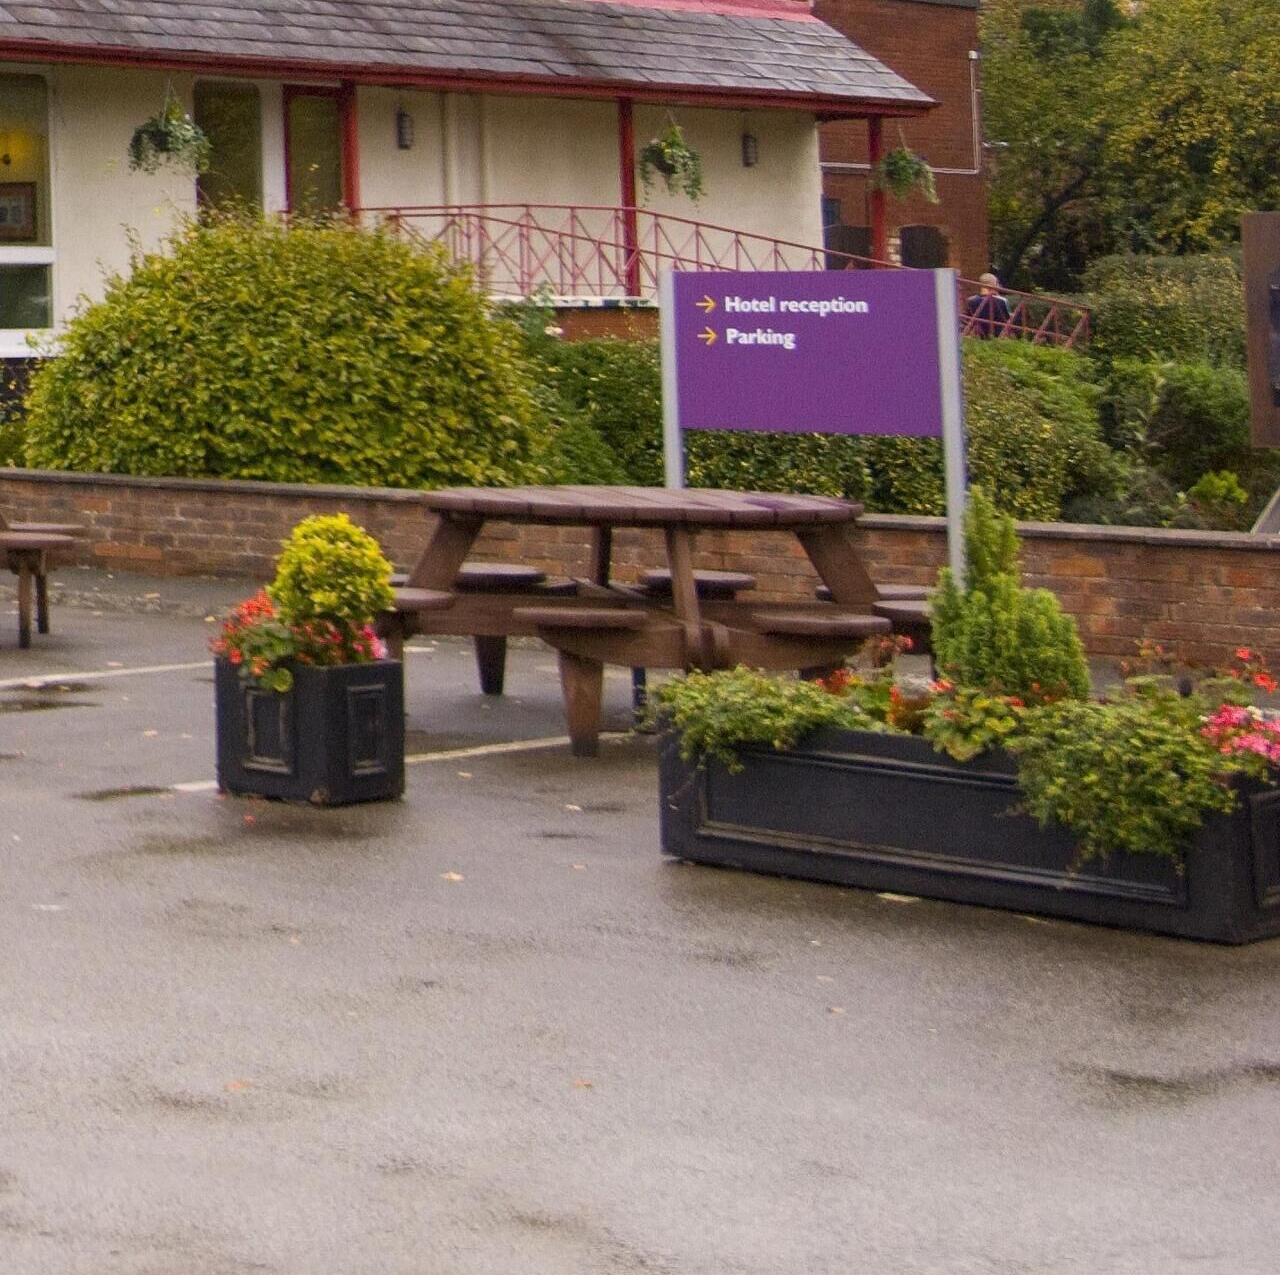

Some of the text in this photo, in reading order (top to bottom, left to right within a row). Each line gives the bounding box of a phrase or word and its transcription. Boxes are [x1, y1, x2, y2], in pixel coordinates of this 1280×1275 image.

[724, 296, 869, 317] Hotel reception
[726, 328, 796, 350] Parking
